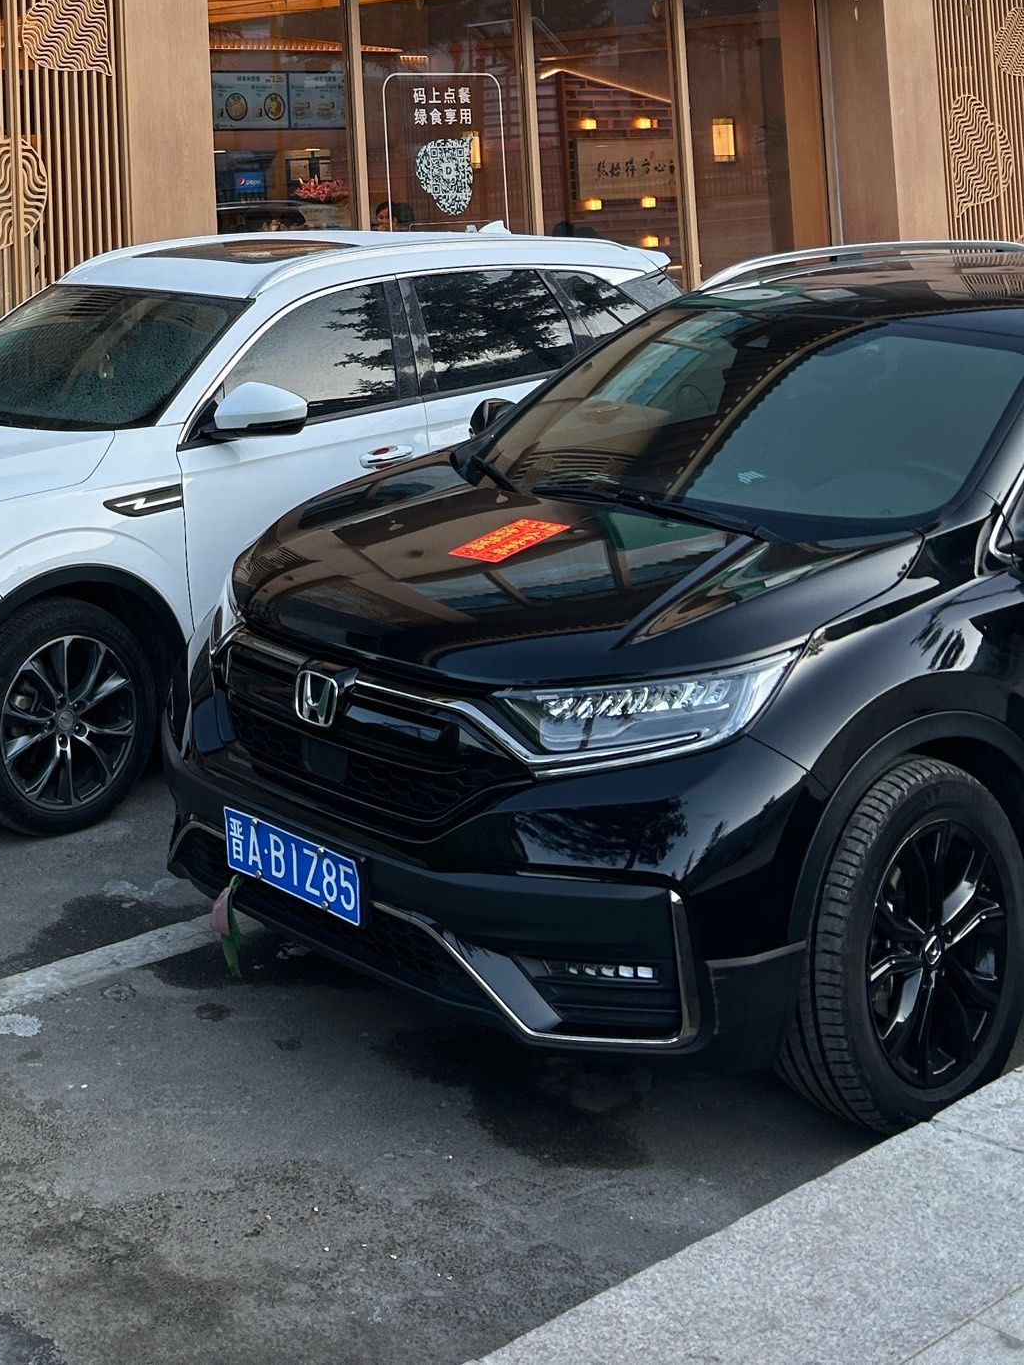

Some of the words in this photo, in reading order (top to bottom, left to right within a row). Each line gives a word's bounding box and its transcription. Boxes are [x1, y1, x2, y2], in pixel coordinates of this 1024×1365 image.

[413, 87, 472, 104] 码上点餐
[414, 108, 473, 125] 绿食享用
